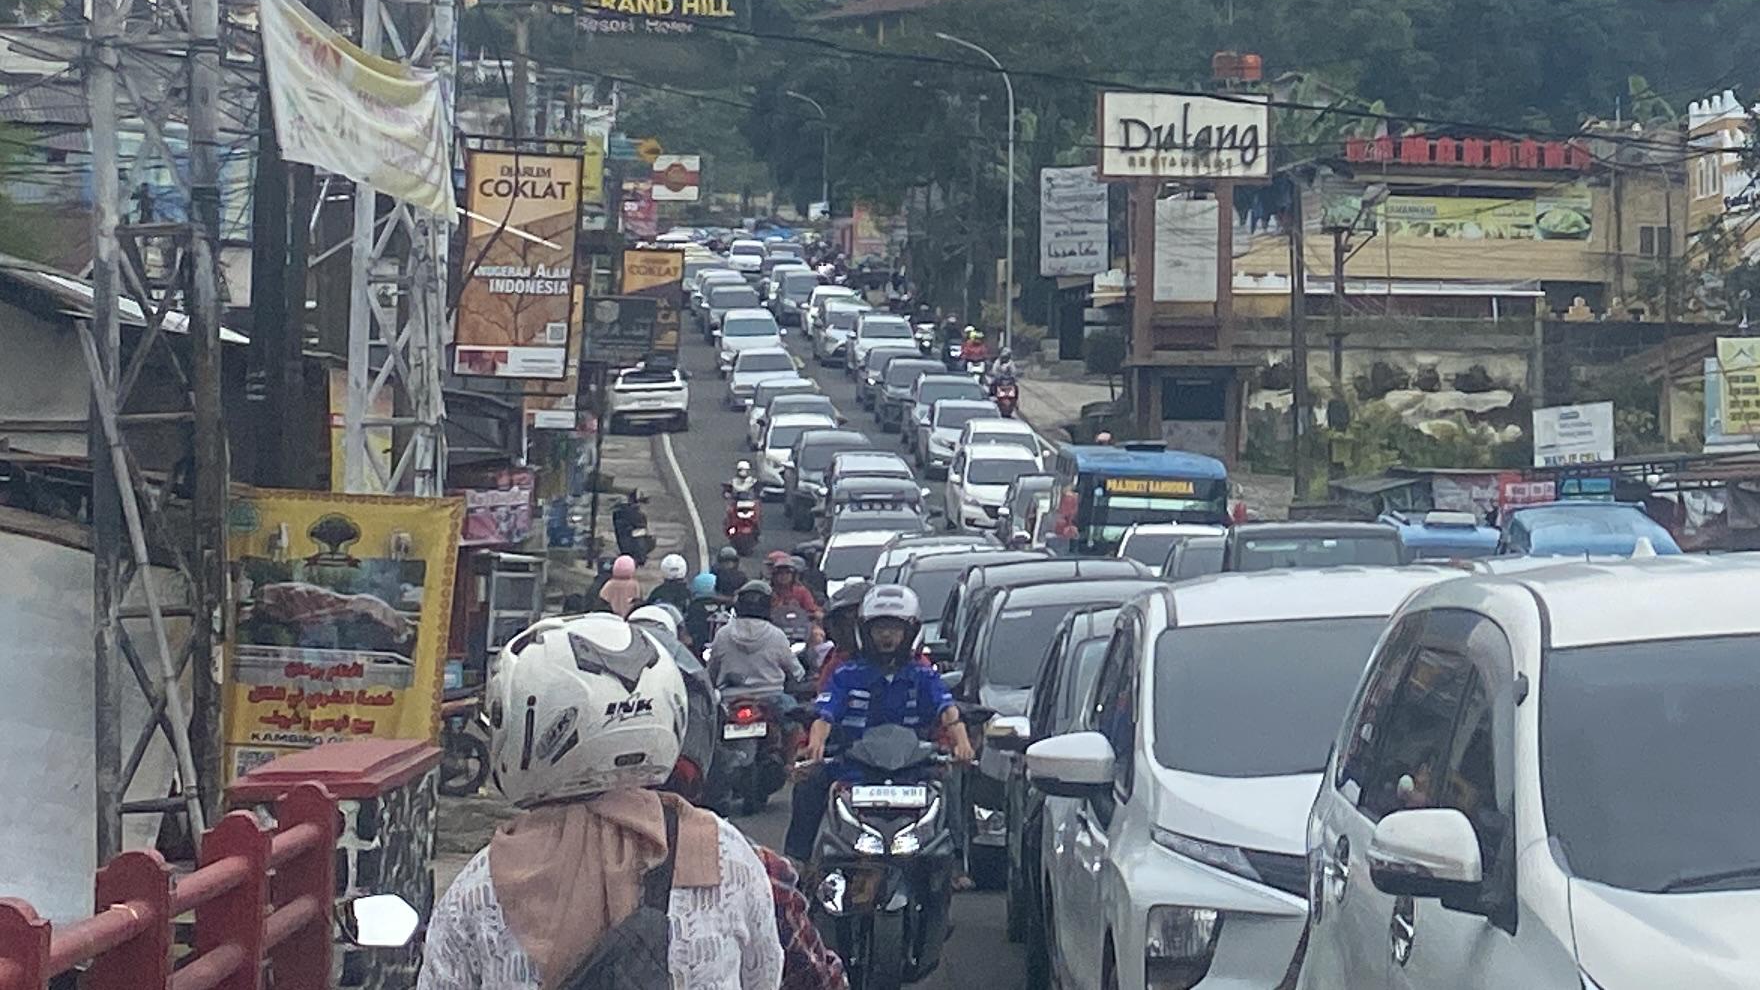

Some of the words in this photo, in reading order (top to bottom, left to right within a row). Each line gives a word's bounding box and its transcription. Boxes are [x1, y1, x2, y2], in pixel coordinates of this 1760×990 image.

[1119, 102, 1260, 166] Dulang
[479, 178, 571, 200] COKLAT
[488, 278, 569, 294] INDONESIA
